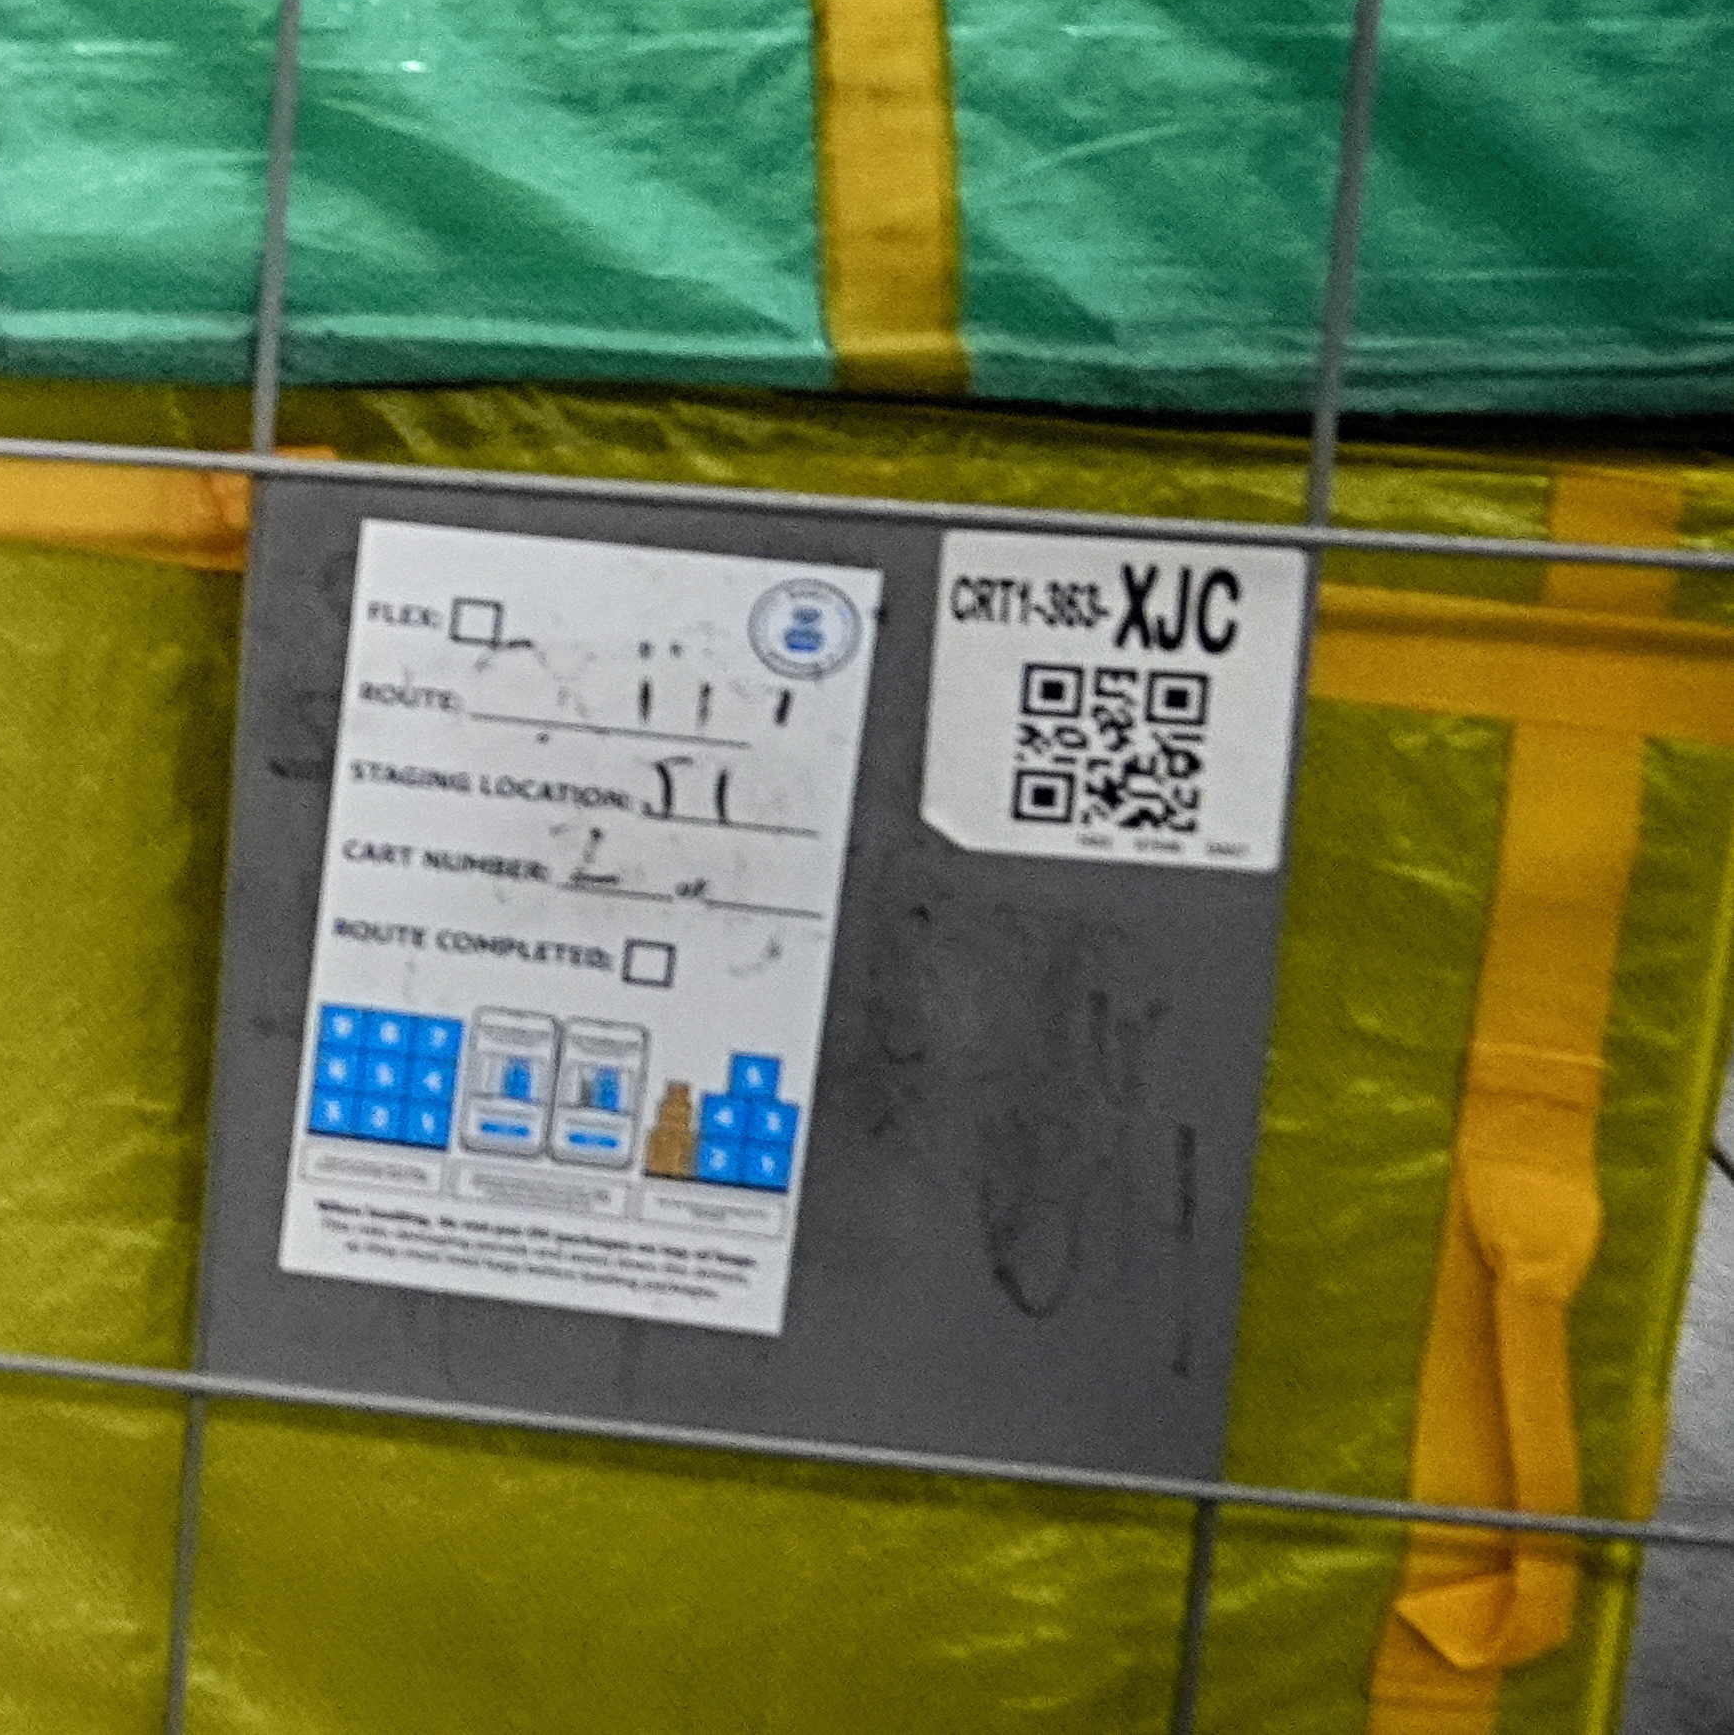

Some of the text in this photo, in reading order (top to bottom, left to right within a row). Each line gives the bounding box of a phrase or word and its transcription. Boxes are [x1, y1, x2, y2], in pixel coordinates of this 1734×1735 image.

[350, 758, 472, 795] STAGING
[341, 836, 413, 867] CART
[333, 915, 428, 949] ROUTE
